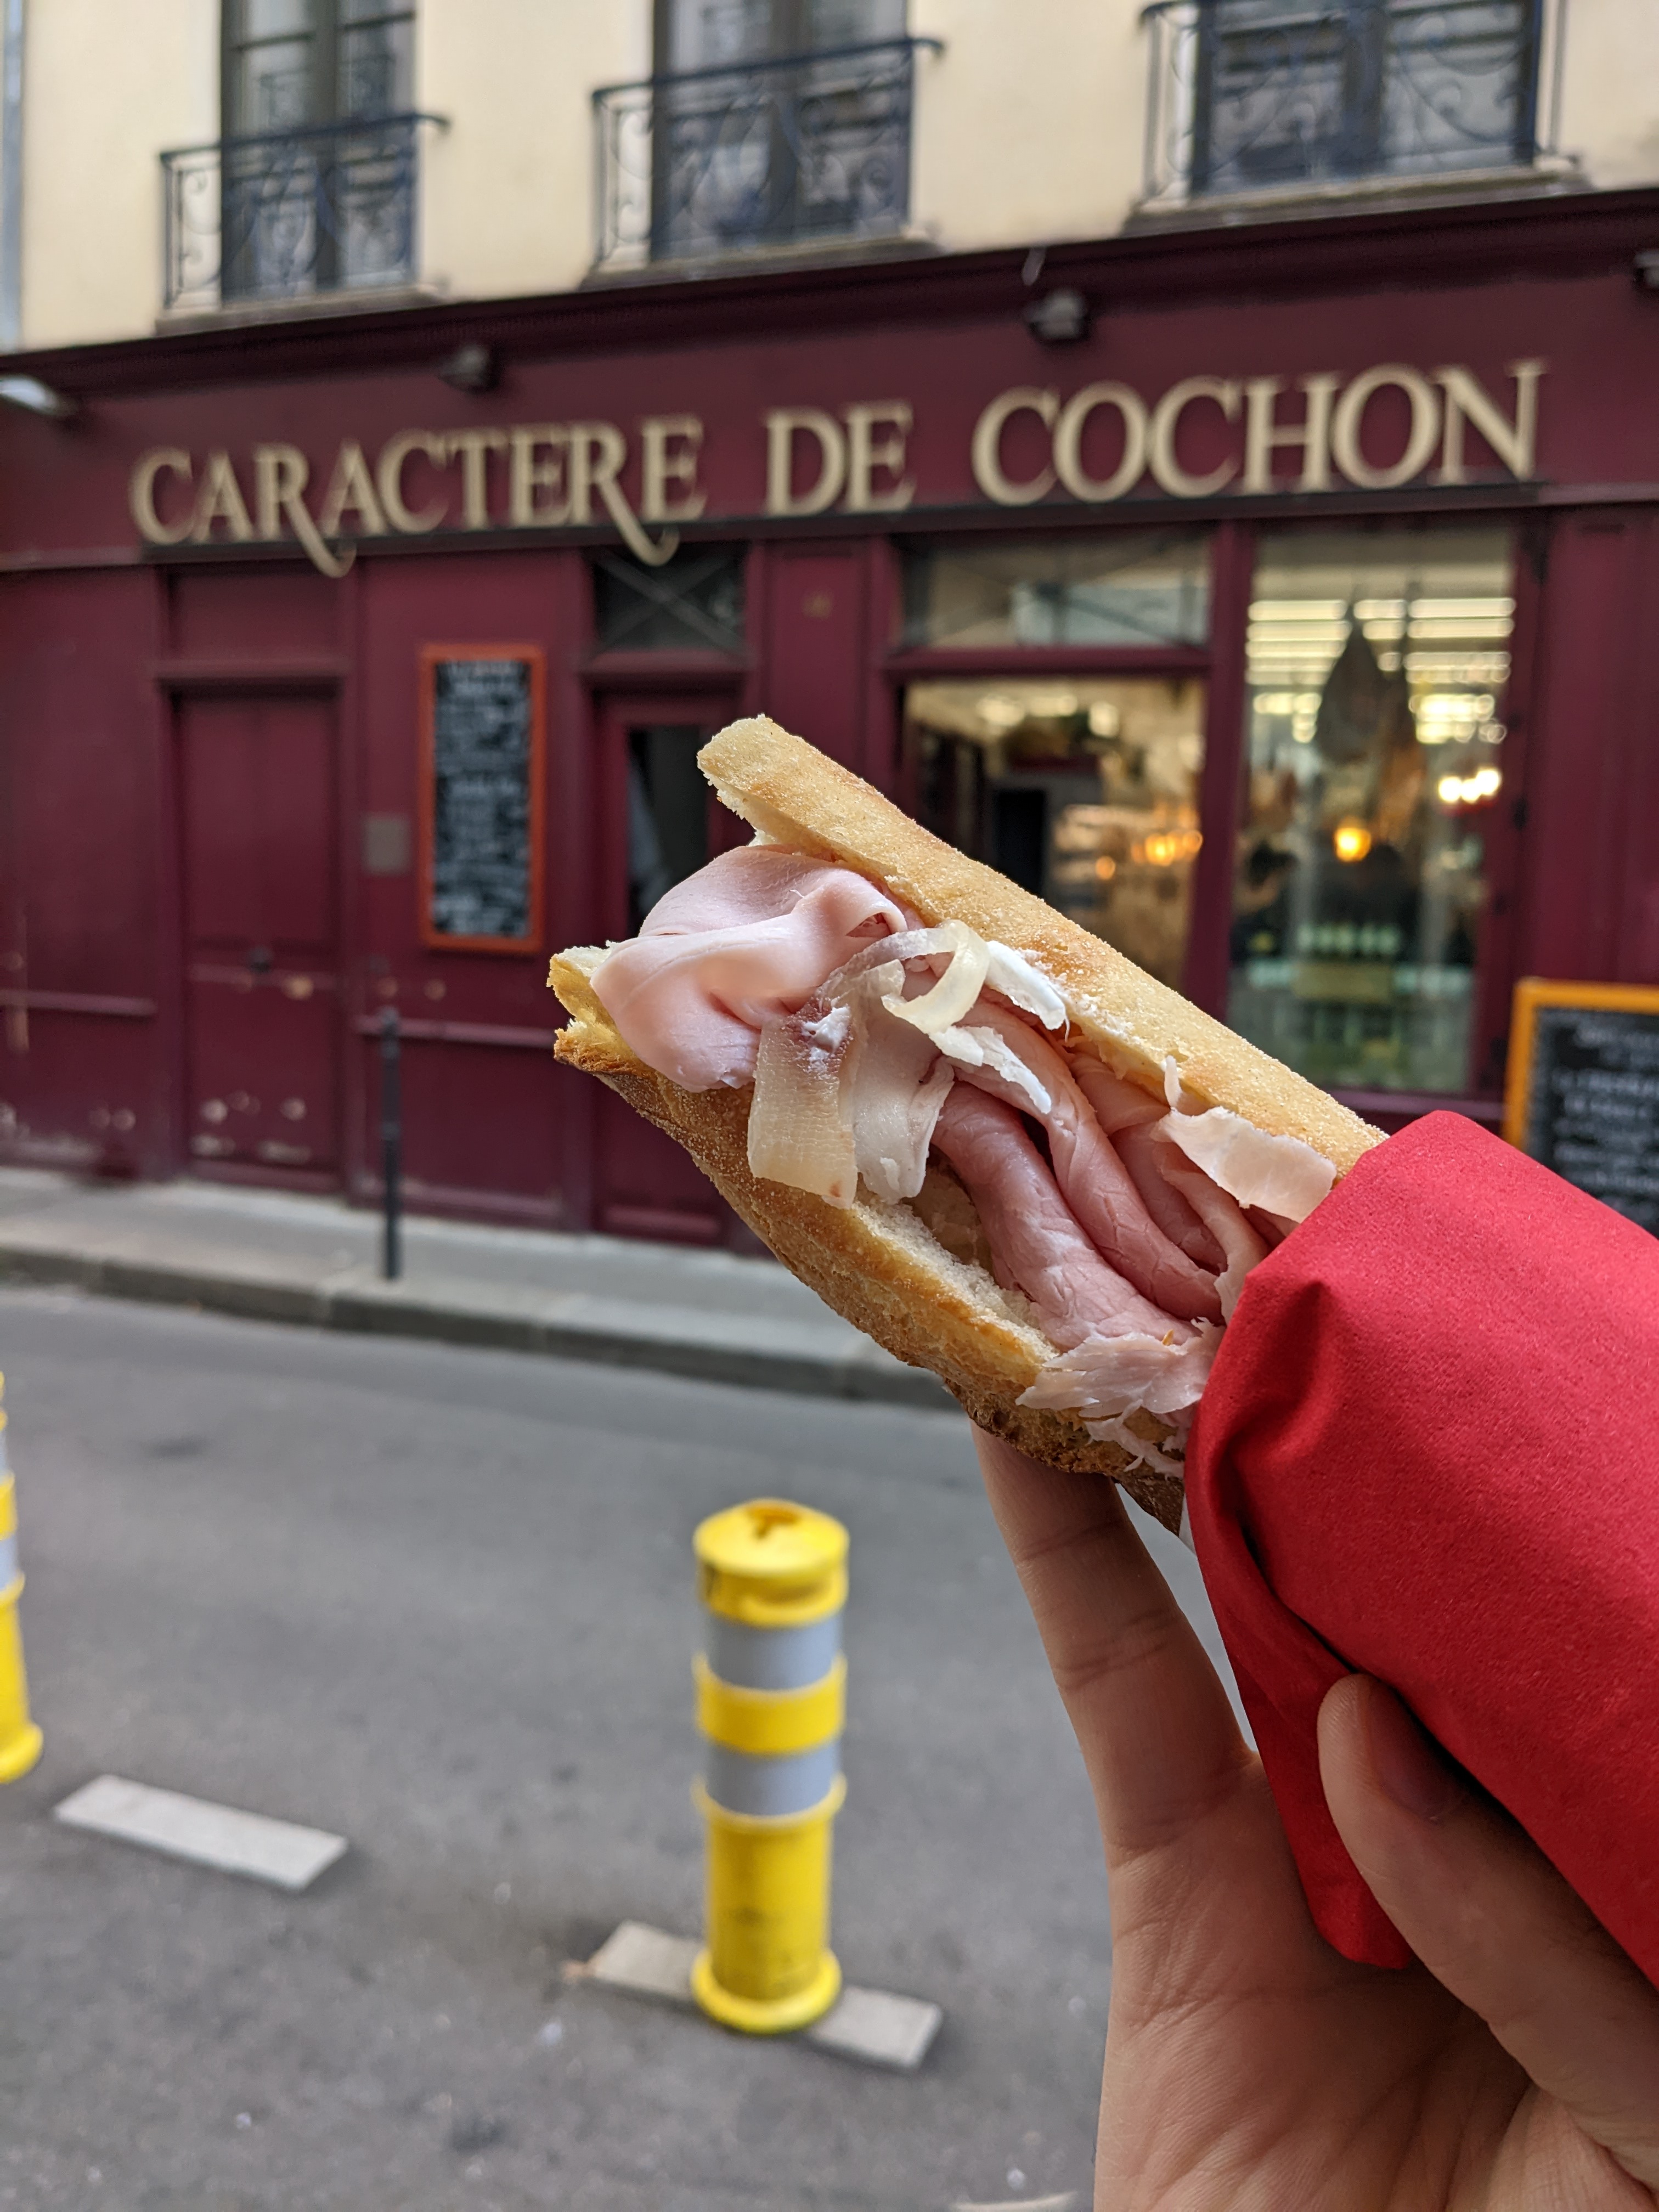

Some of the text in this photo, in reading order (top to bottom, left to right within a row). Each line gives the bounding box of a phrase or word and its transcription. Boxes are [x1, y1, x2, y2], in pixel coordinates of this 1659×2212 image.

[130, 359, 1547, 578] CARACTERE DE COCHON
